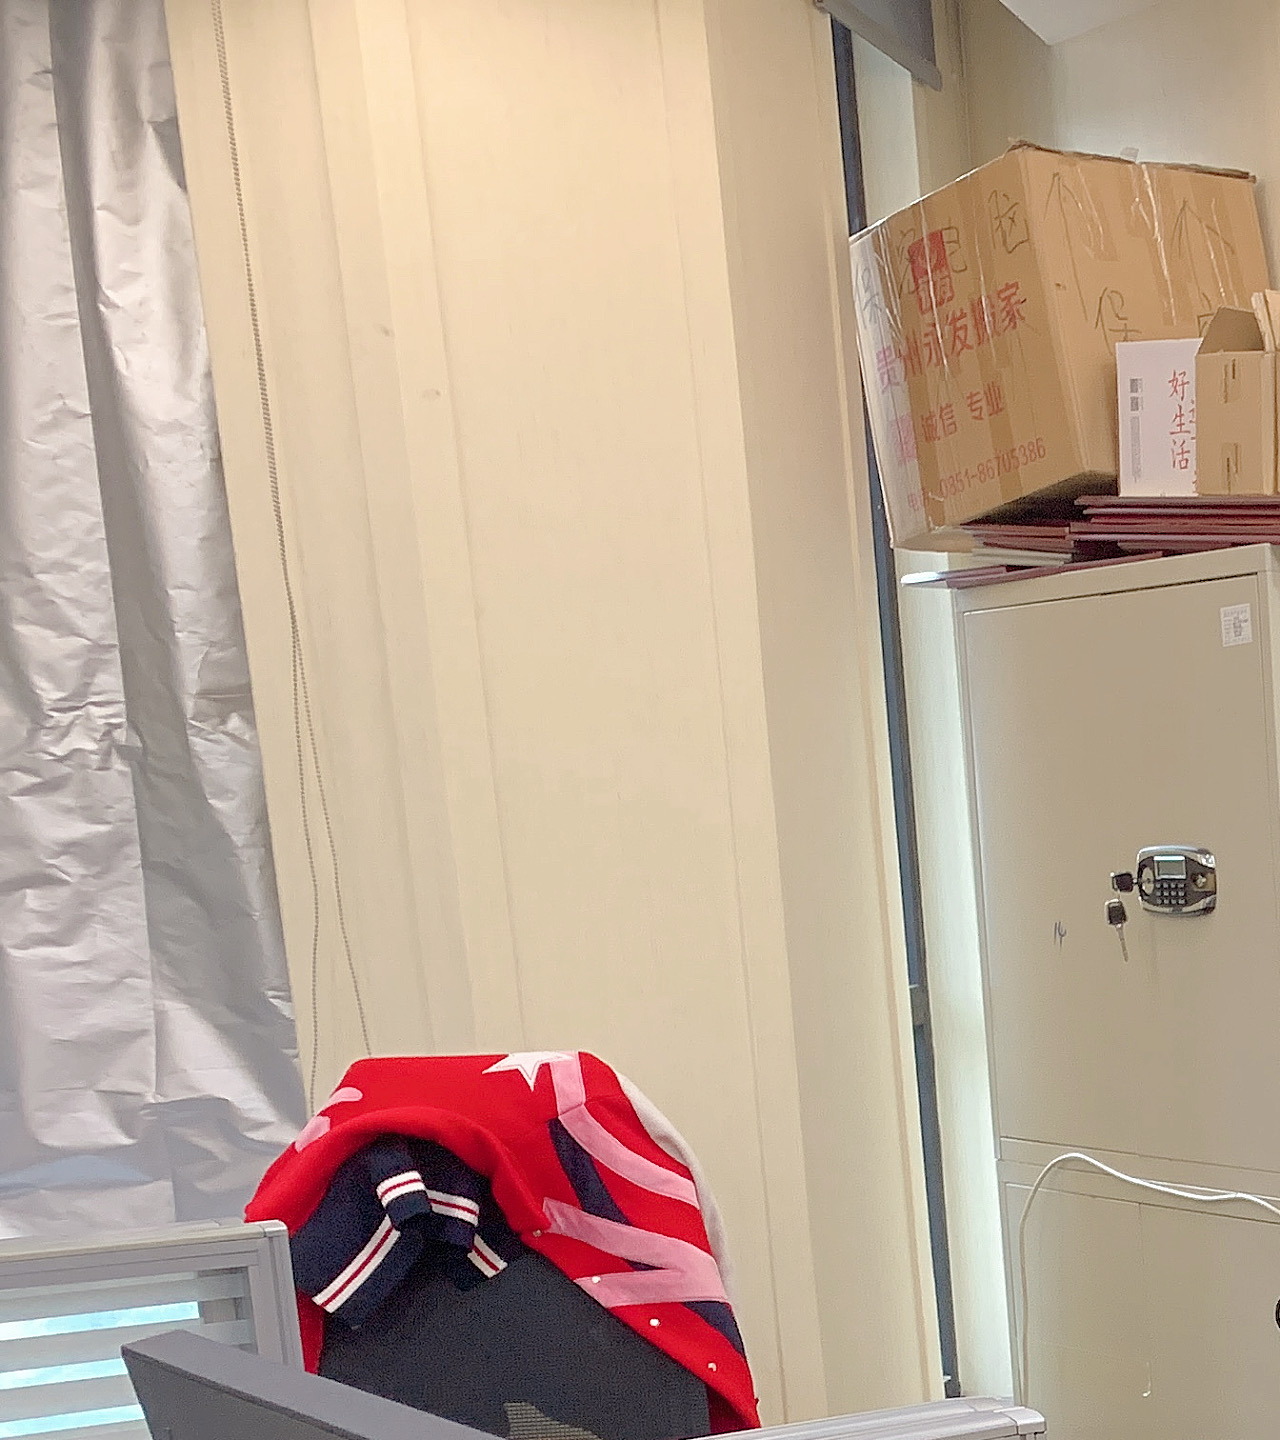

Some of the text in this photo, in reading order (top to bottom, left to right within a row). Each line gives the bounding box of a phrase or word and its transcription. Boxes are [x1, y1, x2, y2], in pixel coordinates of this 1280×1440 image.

[966, 381, 1005, 421] 专业
[1167, 370, 1191, 471] 好生活
